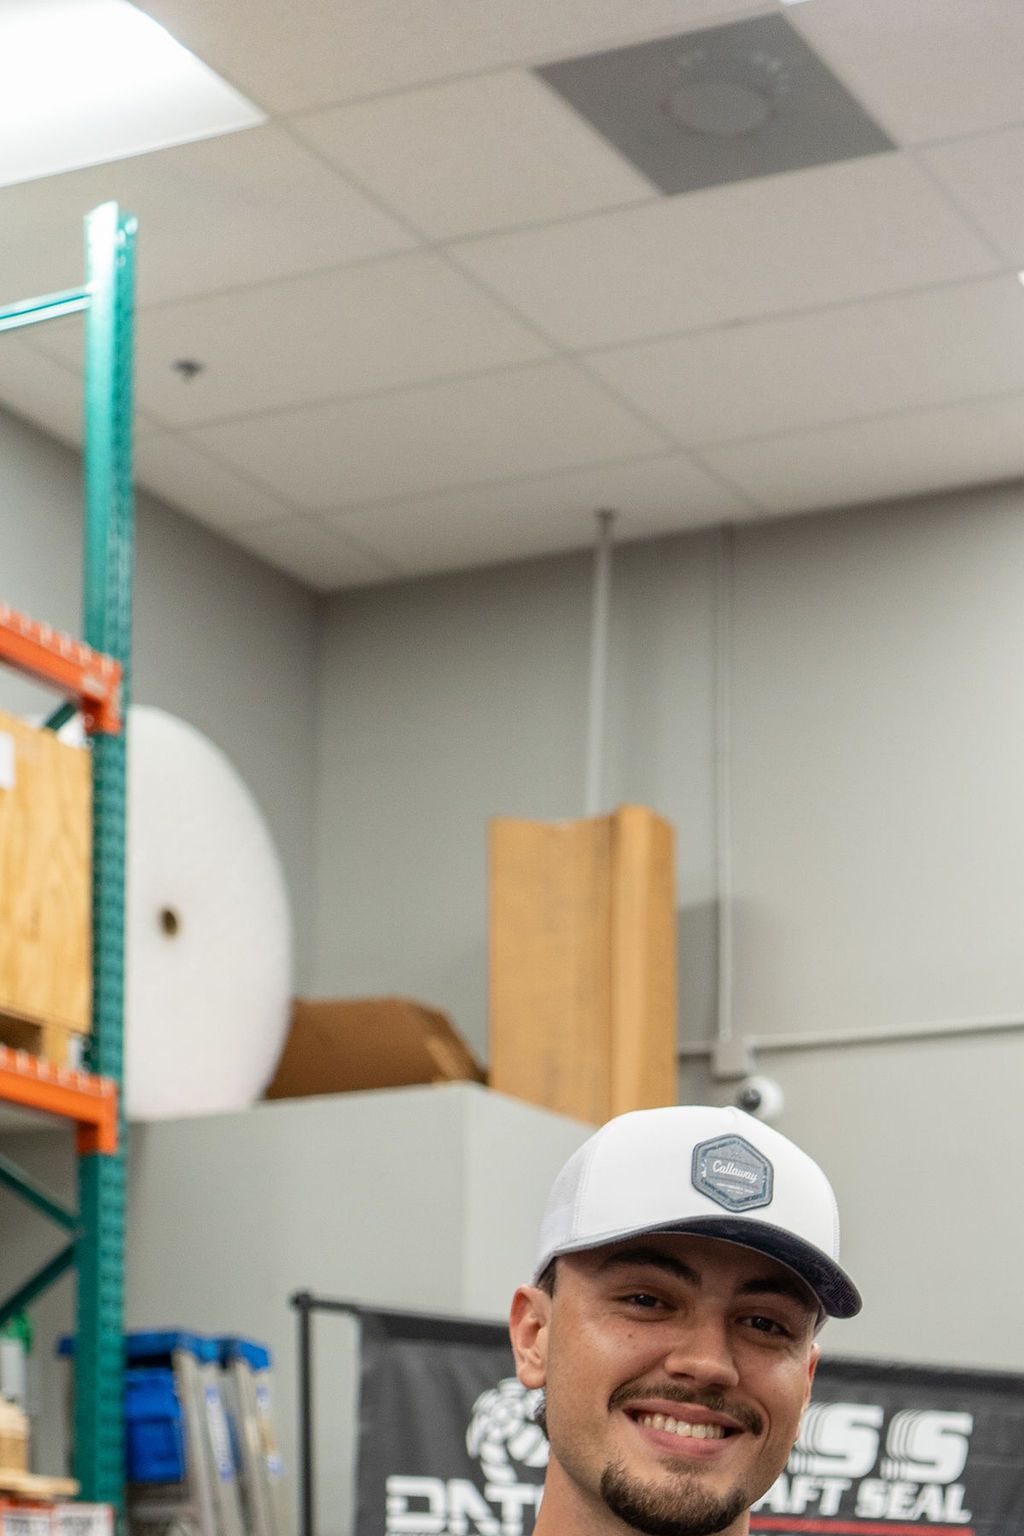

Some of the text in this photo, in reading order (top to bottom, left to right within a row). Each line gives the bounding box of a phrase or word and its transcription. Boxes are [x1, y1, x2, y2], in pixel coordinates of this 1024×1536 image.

[712, 1159, 758, 1184] Callaway
[788, 1401, 973, 1484] SS
[751, 1474, 973, 1524] AFT SEAL
